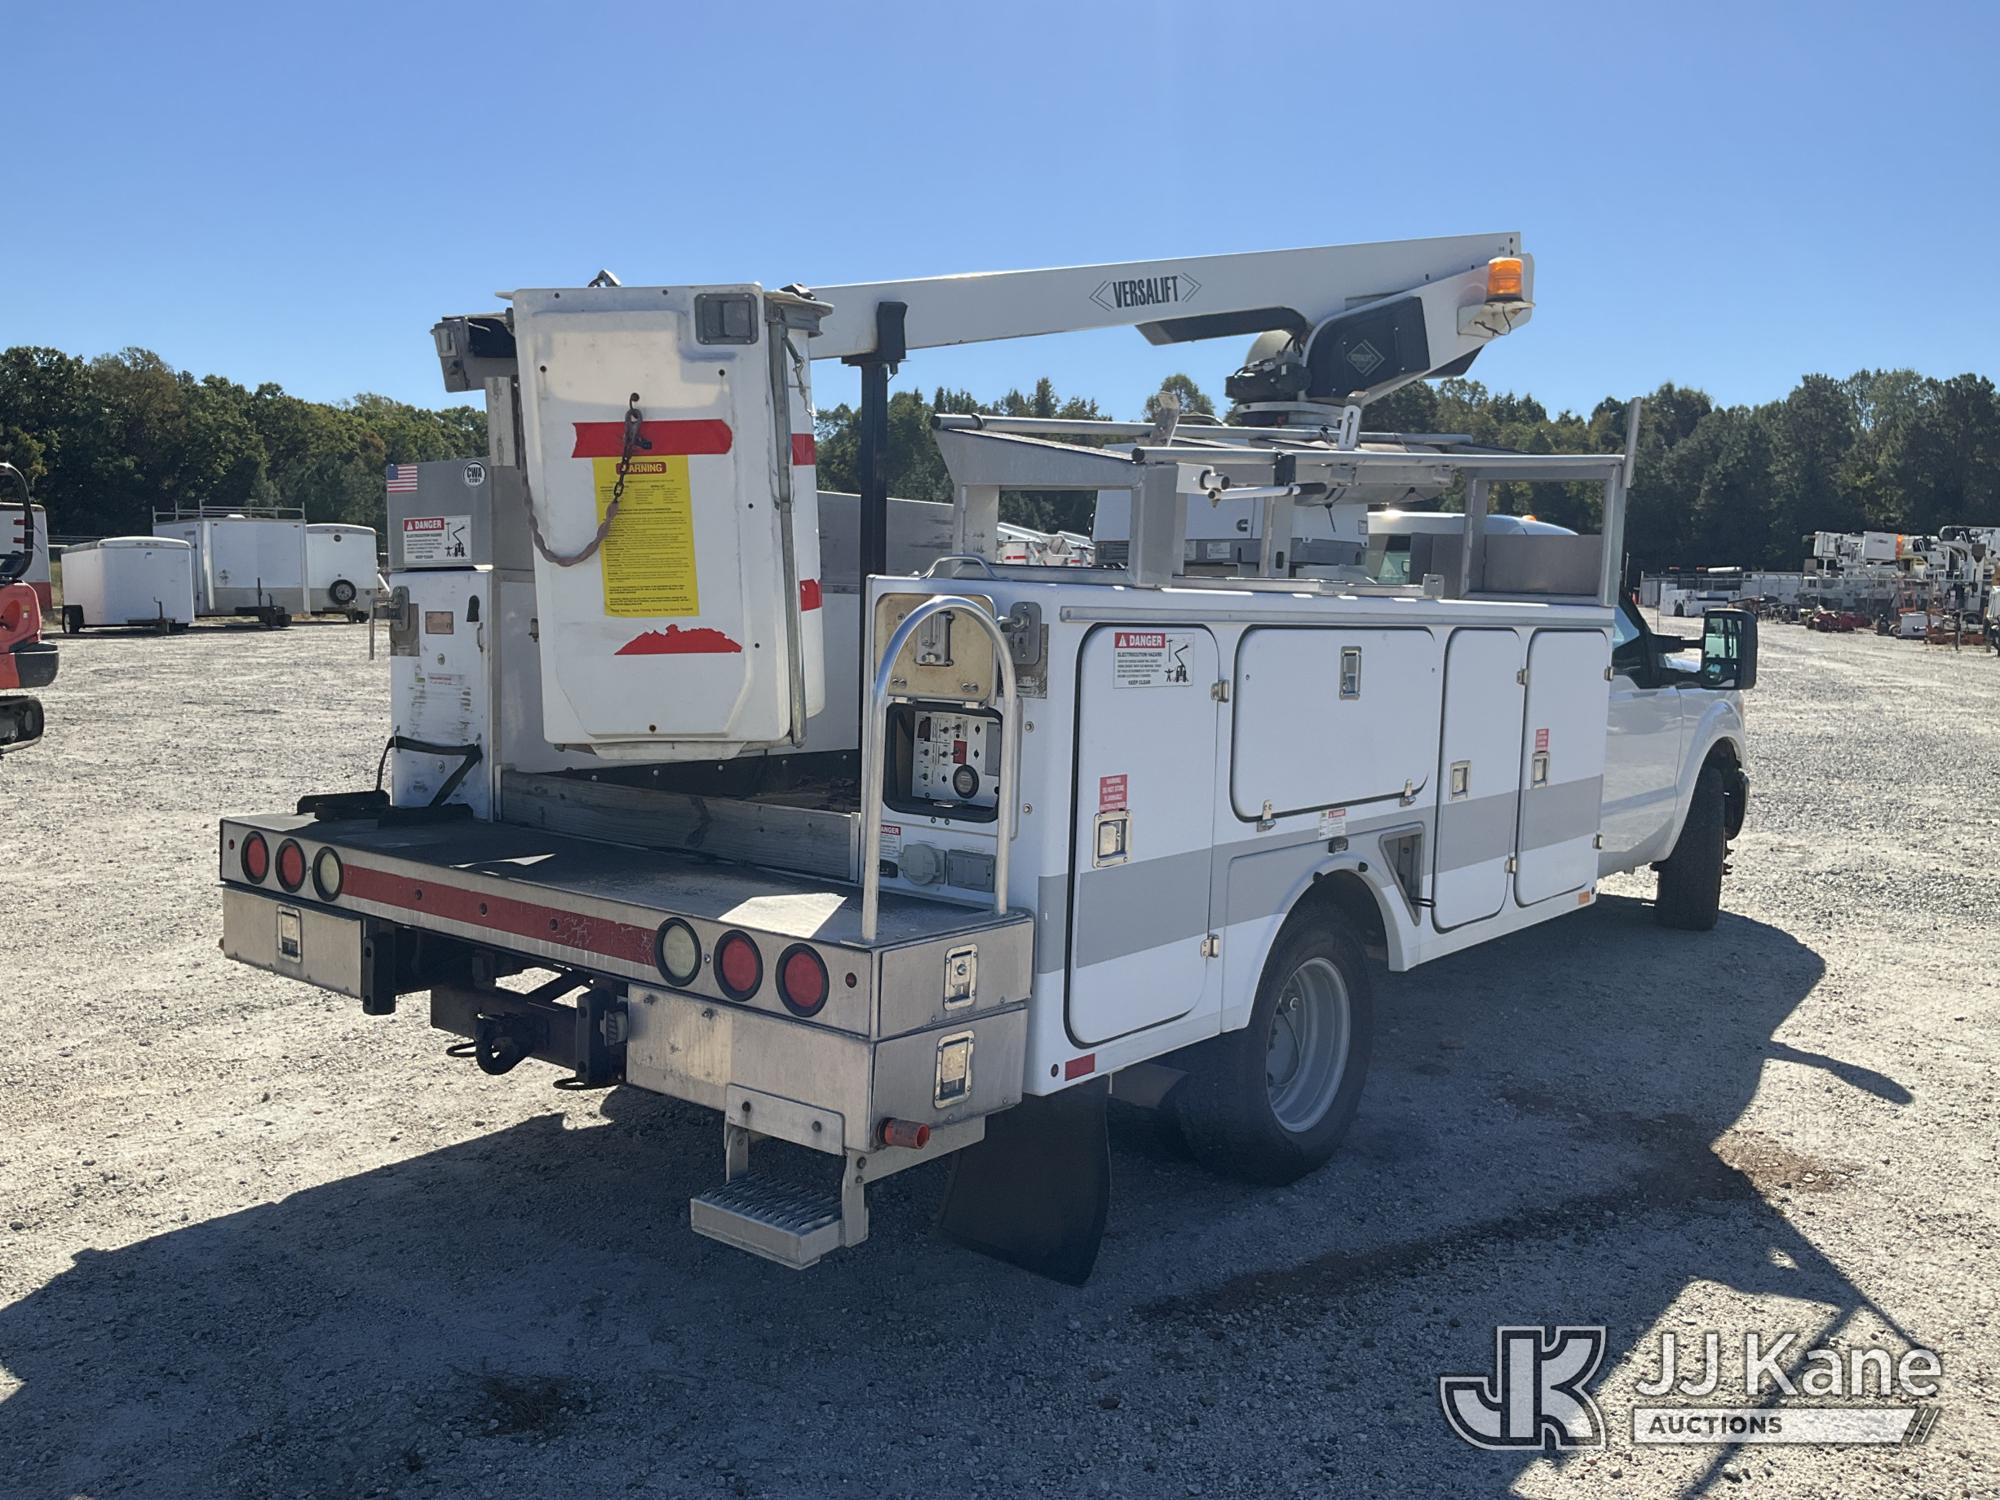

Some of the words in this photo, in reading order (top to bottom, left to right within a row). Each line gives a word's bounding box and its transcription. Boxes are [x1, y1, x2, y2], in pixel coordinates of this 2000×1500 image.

[1112, 276, 1178, 308] VERSALIFT
[467, 467, 482, 478] CWA
[415, 520, 442, 530] DANGER
[1129, 635, 1162, 647] DANGER
